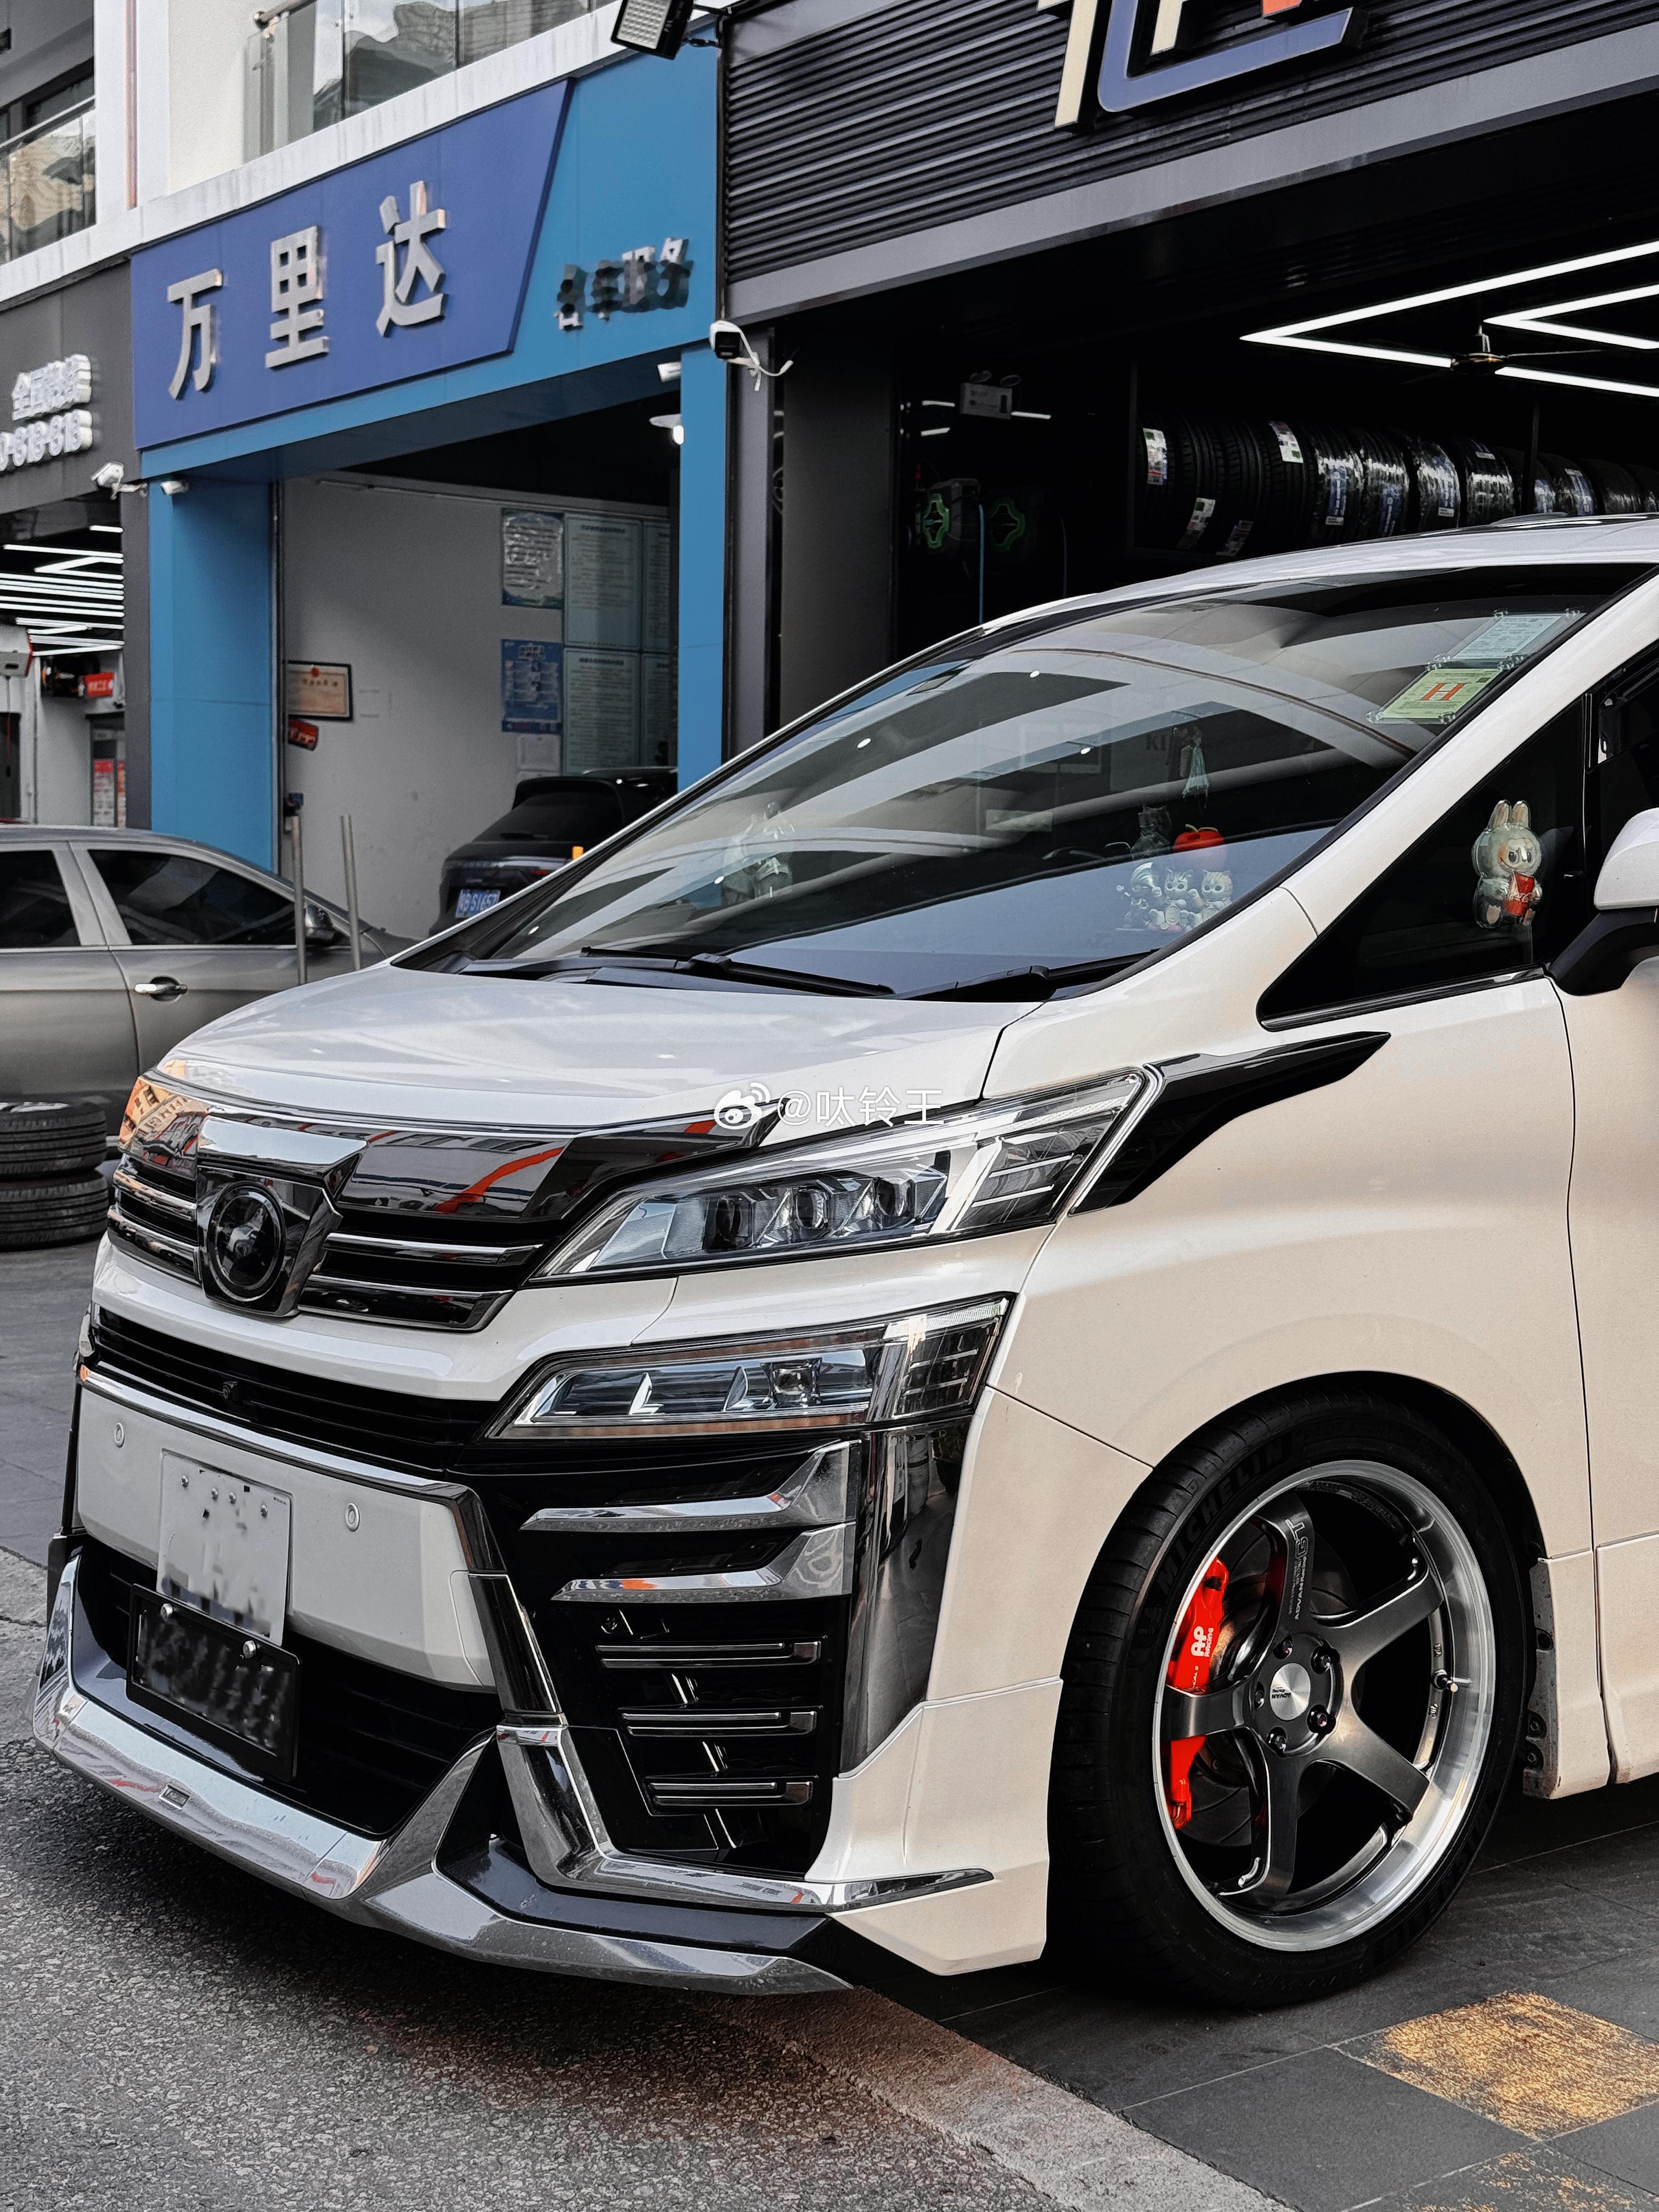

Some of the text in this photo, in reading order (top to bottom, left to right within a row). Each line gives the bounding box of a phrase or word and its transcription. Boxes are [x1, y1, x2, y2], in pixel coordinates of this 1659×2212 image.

[166, 180, 448, 400] 万里达
[1415, 682, 1471, 701] H
[1156, 1441, 1283, 1595] MICHELIN
[1190, 1626, 1206, 1657] AP
